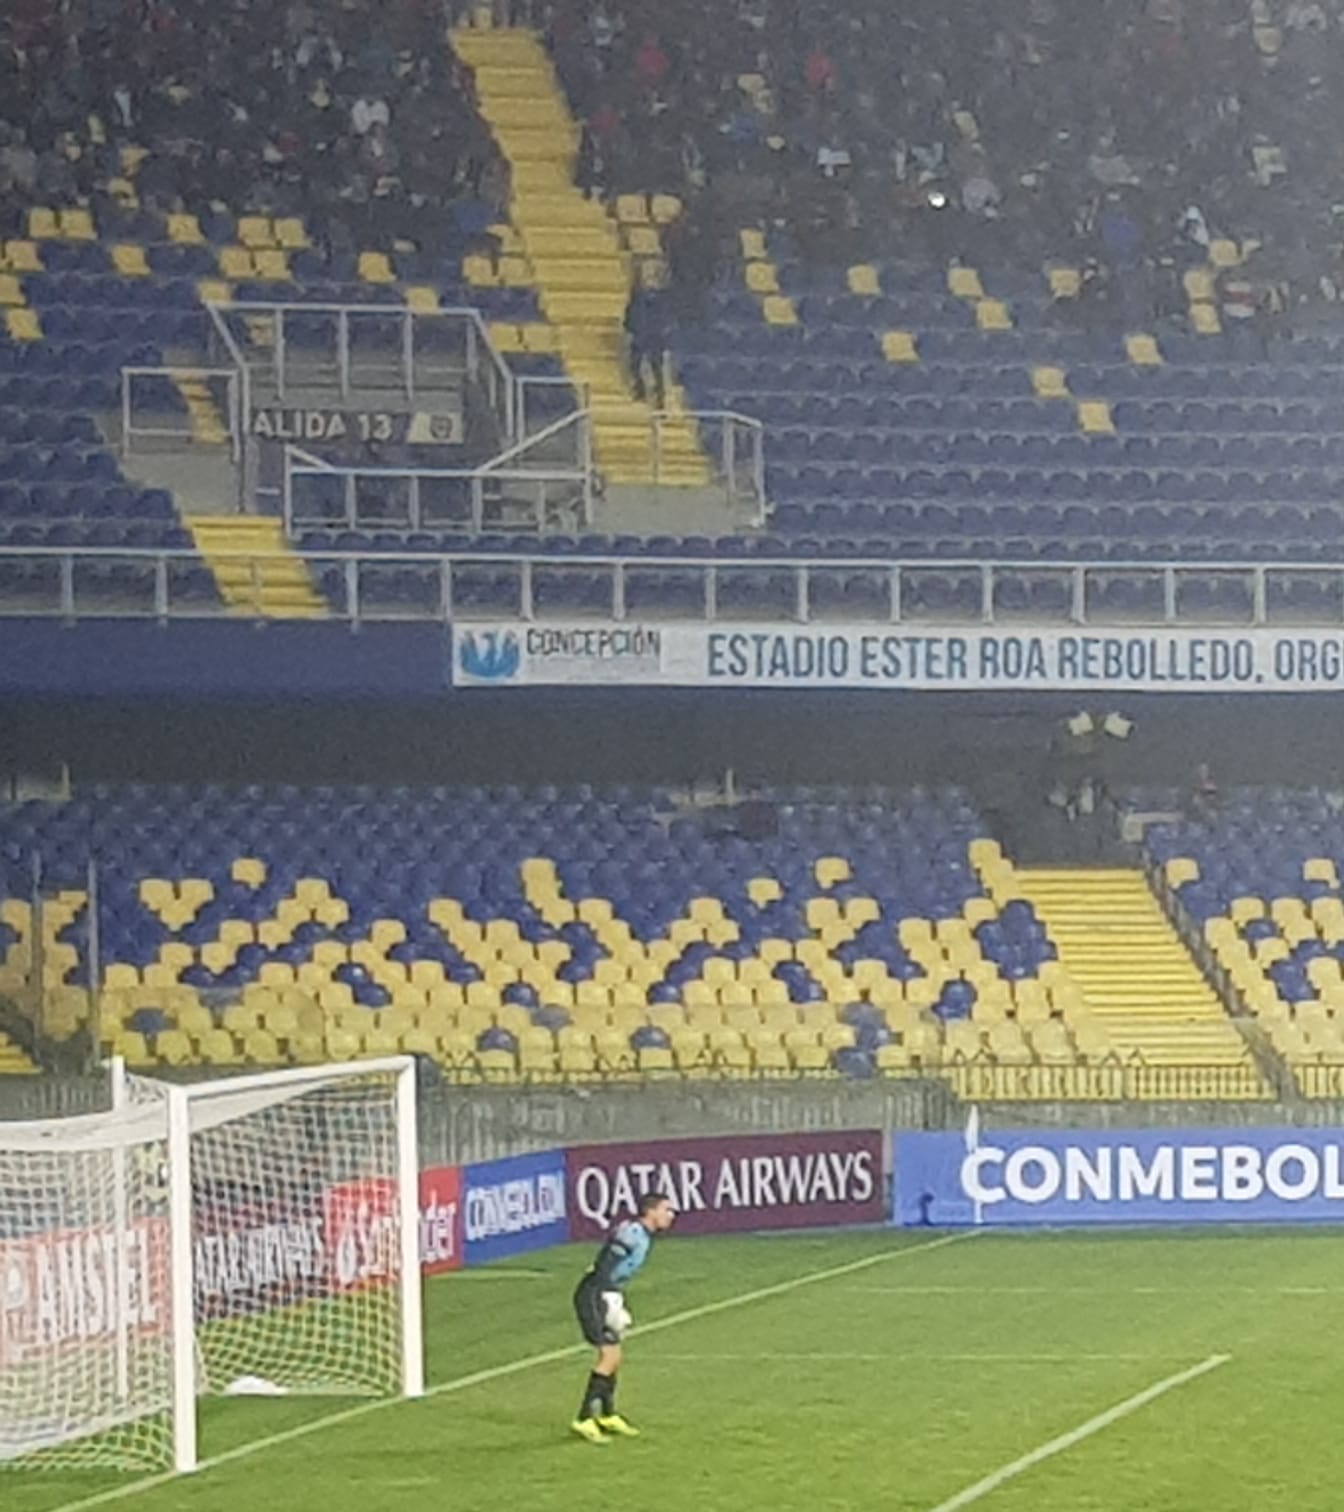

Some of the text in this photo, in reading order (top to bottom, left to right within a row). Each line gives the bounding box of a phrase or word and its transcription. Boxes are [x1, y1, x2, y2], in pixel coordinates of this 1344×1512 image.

[253, 410, 393, 440] ALIDA 13
[708, 633, 850, 679] ESTADIO
[861, 635, 968, 681] ESTER
[979, 637, 1047, 681] ROA
[576, 1150, 873, 1230] QATAR AIRWAYS
